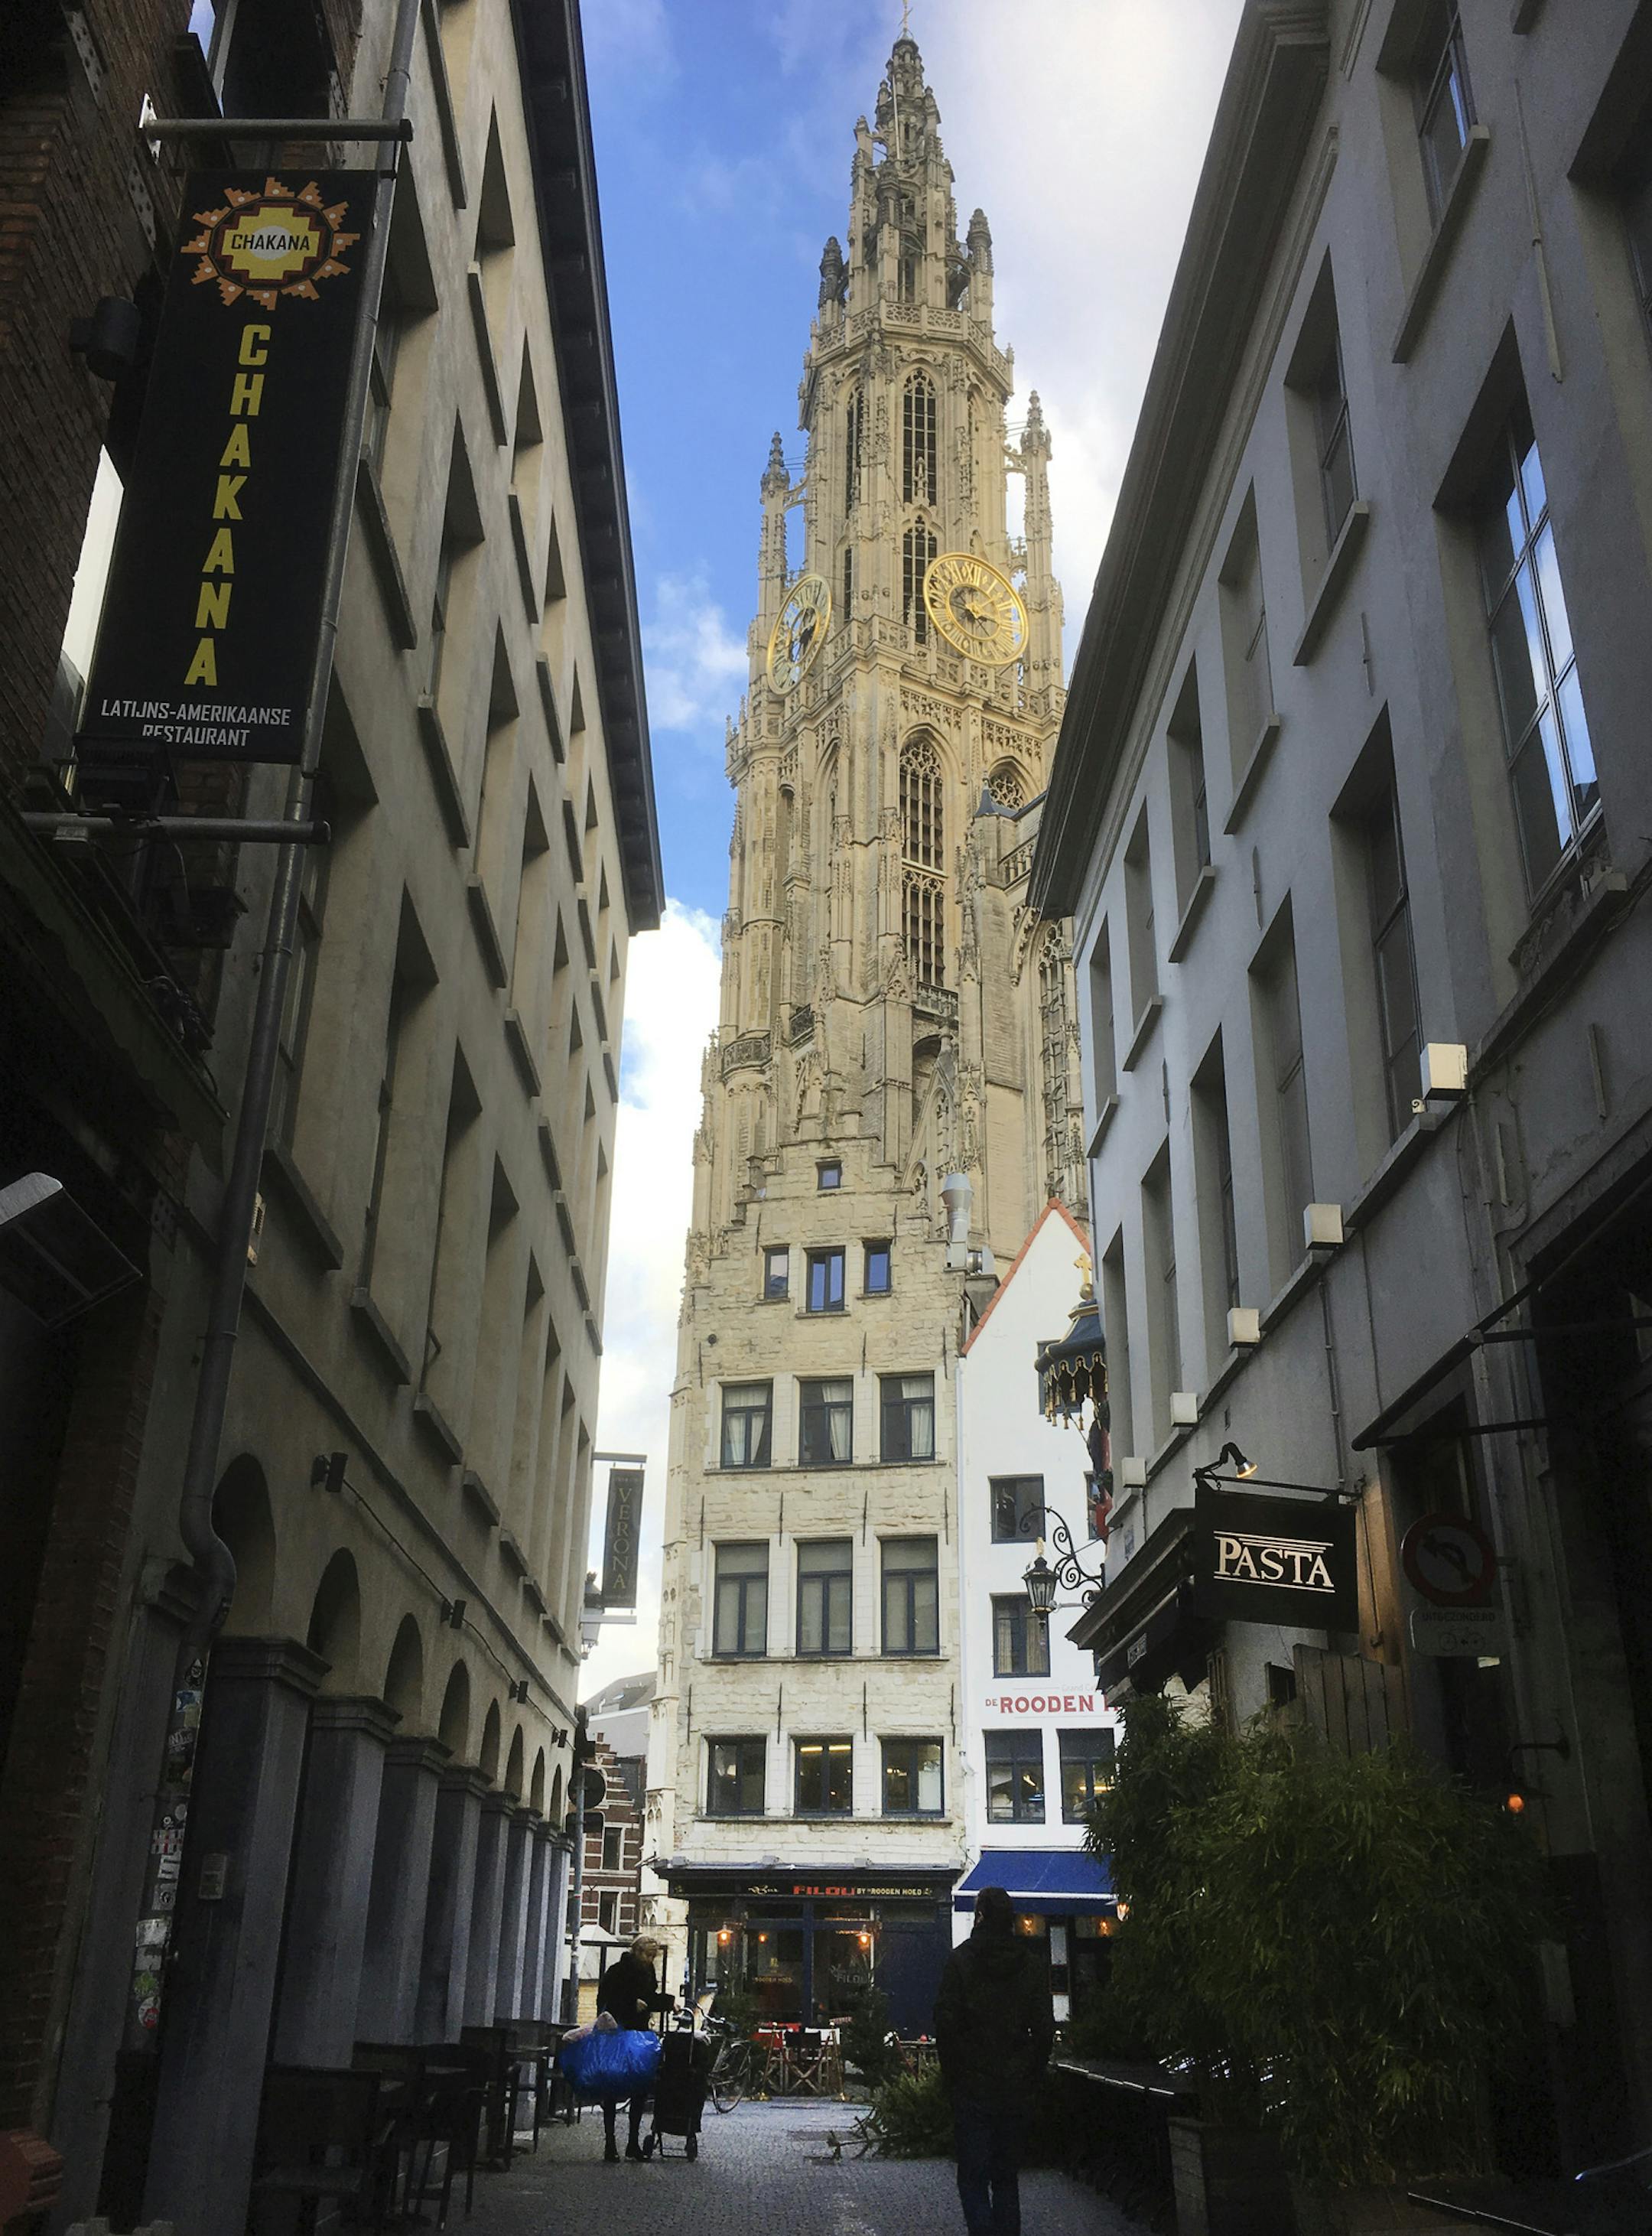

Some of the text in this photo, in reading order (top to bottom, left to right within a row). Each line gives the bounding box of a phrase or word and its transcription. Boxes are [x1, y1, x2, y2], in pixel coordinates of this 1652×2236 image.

[231, 234, 310, 251] CHAKANA
[184, 324, 271, 687] CHAKANA
[101, 699, 291, 725] LATIJNS-AMERIKAANSE
[142, 724, 250, 746] RESTAURANT
[612, 1487, 633, 1590] VERONA
[1214, 1536, 1335, 1587] PASTA
[1000, 1695, 1093, 1714] ROODEN
